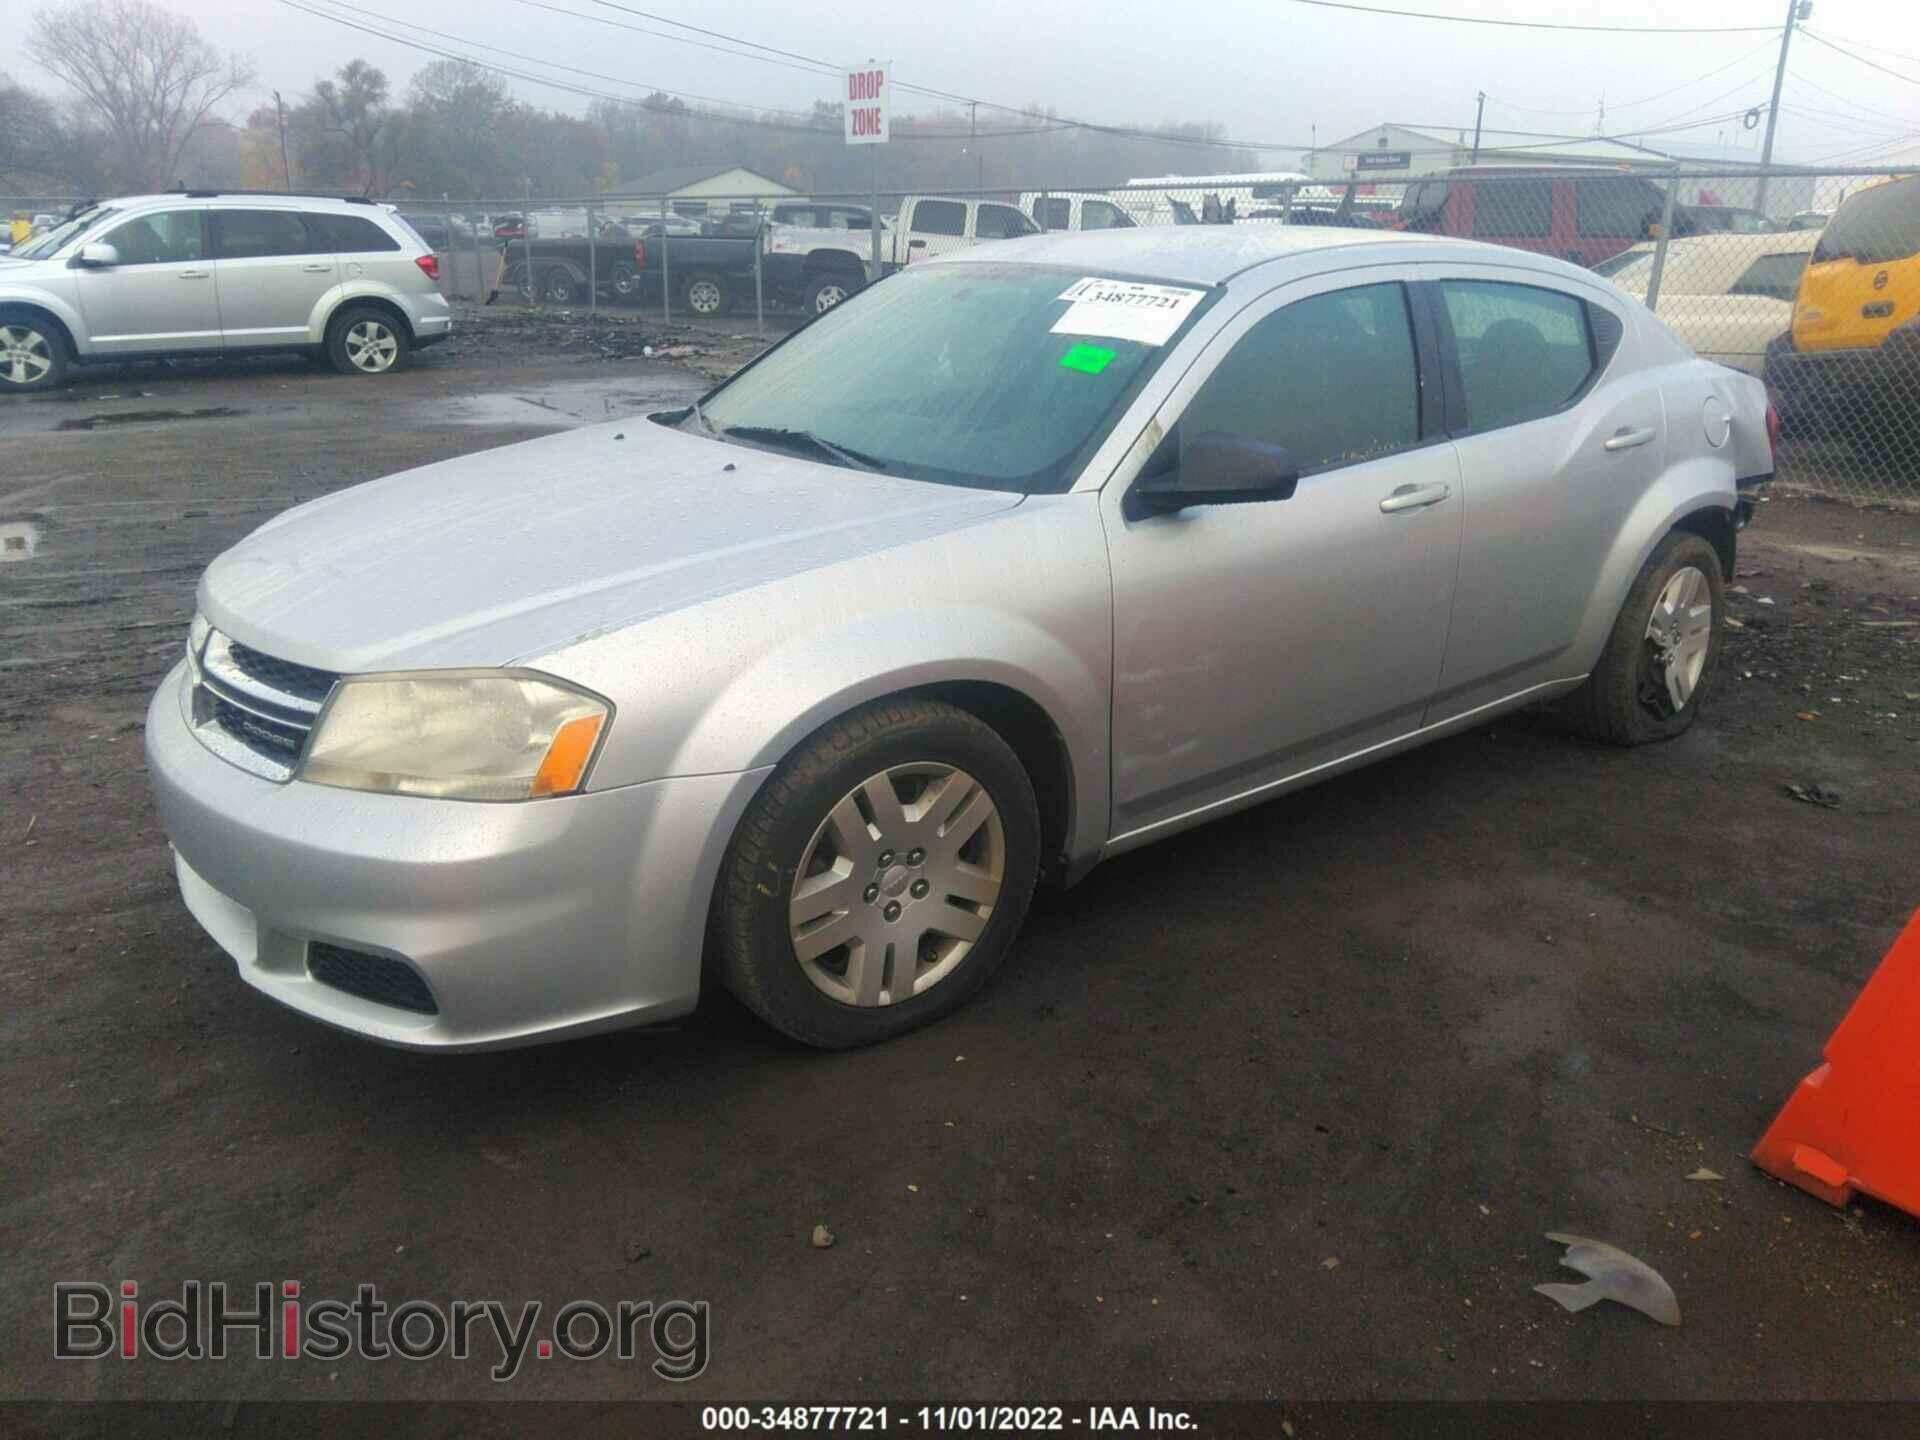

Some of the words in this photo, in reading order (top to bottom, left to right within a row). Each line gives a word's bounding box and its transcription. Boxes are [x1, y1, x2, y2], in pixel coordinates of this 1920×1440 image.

[848, 70, 884, 101] DROP
[851, 107, 882, 136] ZONE
[1088, 291, 1180, 310] 34877721
